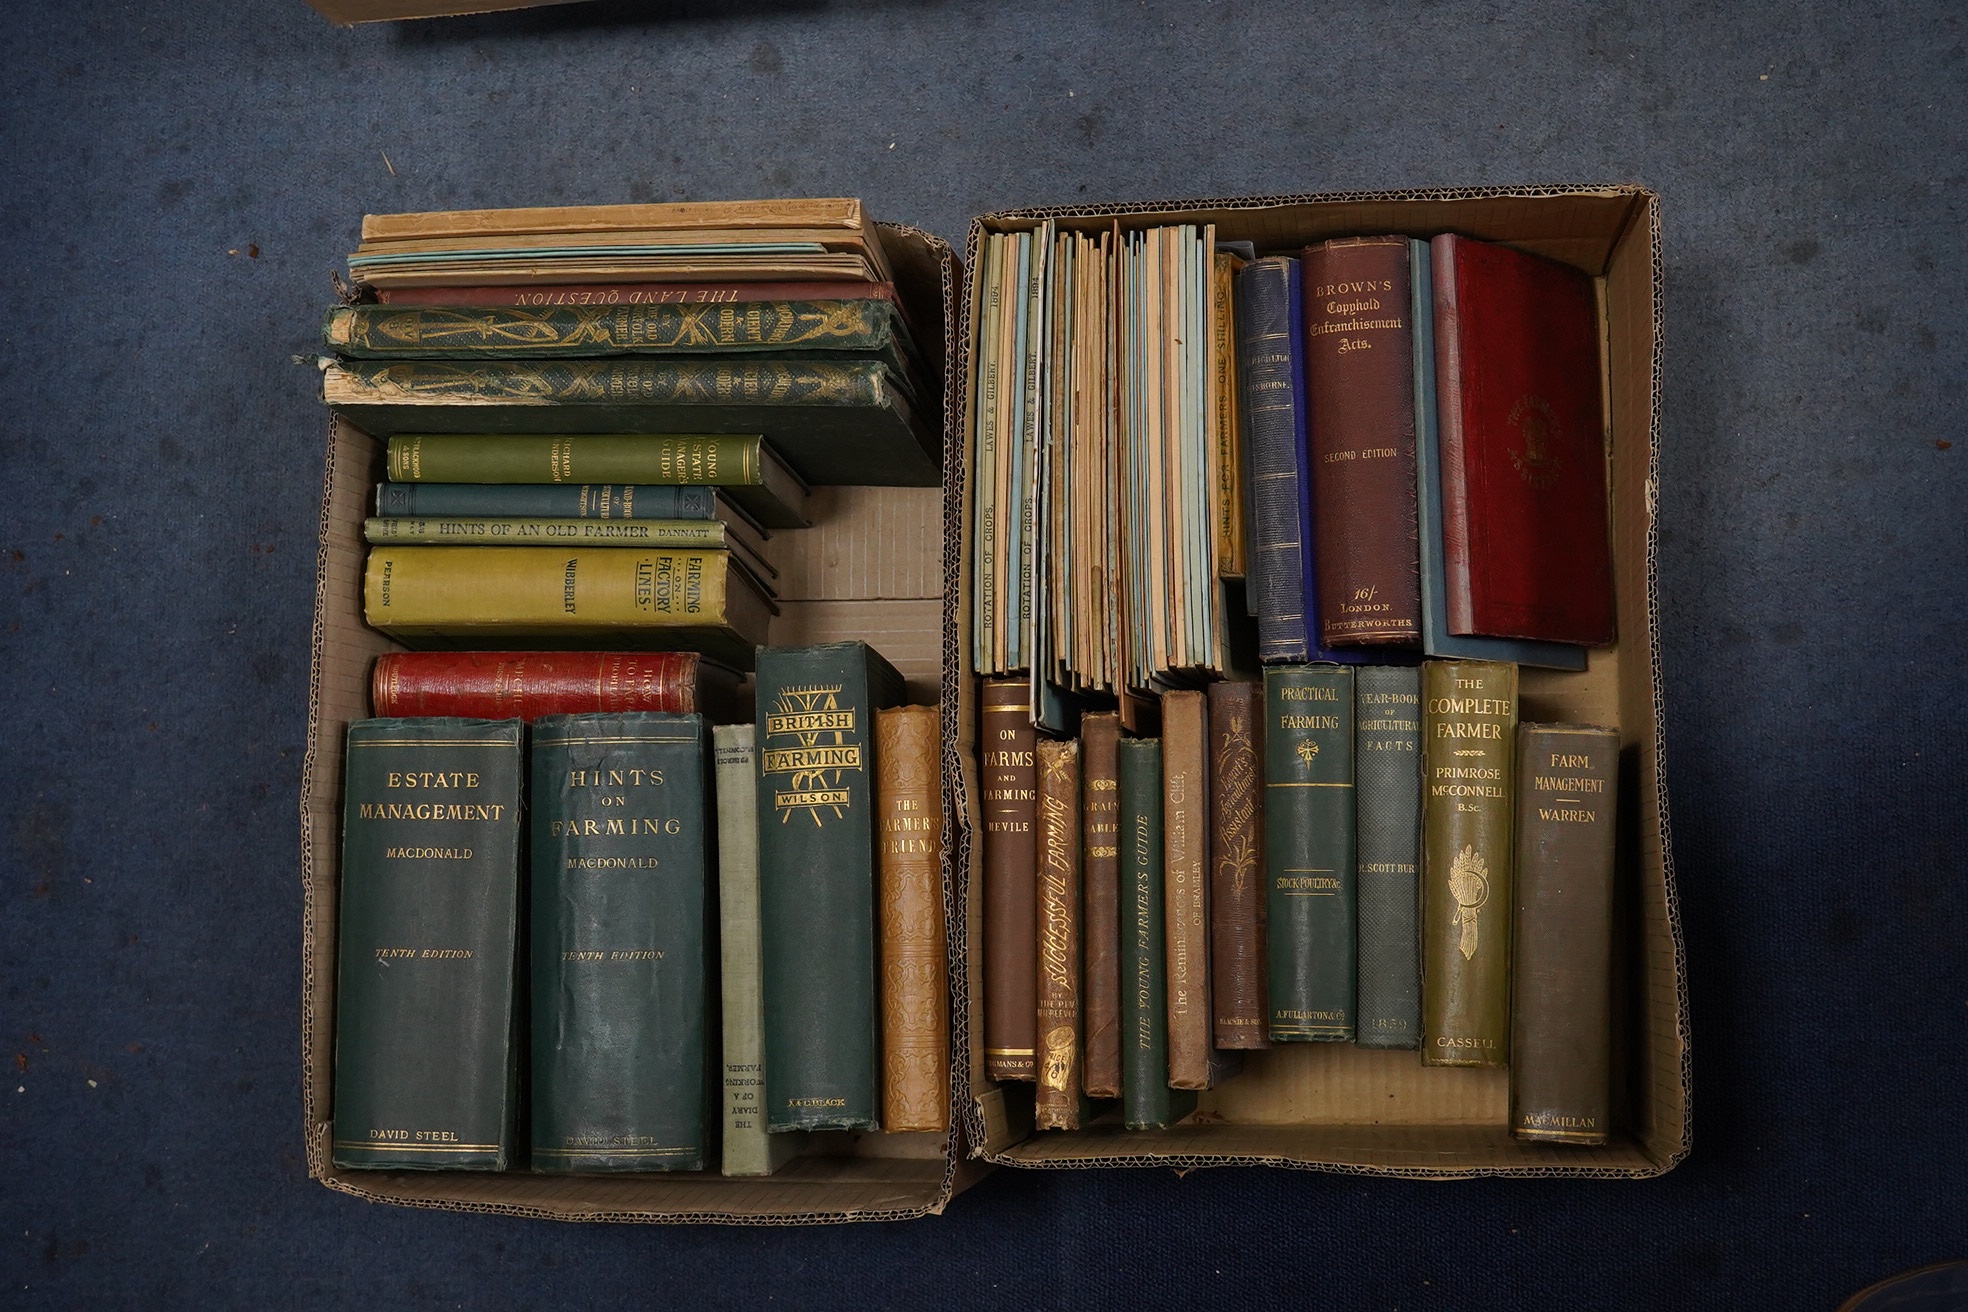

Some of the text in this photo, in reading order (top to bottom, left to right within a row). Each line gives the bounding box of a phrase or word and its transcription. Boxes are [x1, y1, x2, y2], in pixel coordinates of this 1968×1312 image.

[628, 290, 687, 304] LAND
[696, 290, 738, 304] THE
[1315, 280, 1393, 298] BROWN'S
[1326, 298, 1381, 316] Copyhold
[647, 322, 657, 341] OLD
[719, 307, 735, 342] ODERN
[1309, 317, 1403, 337] Enfranchisement
[1337, 338, 1372, 356] Acts.
[1028, 350, 1038, 391] GILBERT.
[1218, 358, 1227, 384] ONE
[987, 360, 997, 401] GILBERT.
[1027, 398, 1035, 406] &
[1026, 413, 1035, 443] LAWES
[1217, 396, 1229, 456] FARMERS
[984, 421, 995, 452] LAWES
[402, 451, 410, 470] SONS
[662, 438, 673, 479] GUIDE
[692, 437, 705, 480] ESTATE
[706, 439, 718, 479] YOUNG
[1324, 447, 1398, 464] SECOND EDITION
[1221, 464, 1230, 491] FOR
[1024, 494, 1033, 533] CROPS.
[1222, 498, 1230, 538] HINTS
[440, 523, 710, 539] HINTS OF AN OLD FARMER DANNATT
[984, 504, 994, 542] CROPS.
[1023, 540, 1031, 555] OF
[985, 550, 992, 565] OF
[382, 561, 393, 607] PEARSON
[564, 558, 578, 615] WIBBERLEY
[657, 557, 673, 614] FACTORY
[674, 576, 681, 593] ON
[687, 557, 703, 614] FARMING
[1022, 563, 1032, 620] ROTATION
[984, 573, 992, 629] ROTATION
[1354, 585, 1379, 601] 16/-
[627, 660, 638, 676] TO
[642, 669, 653, 703] HOW
[1456, 679, 1484, 689] THE
[1281, 687, 1339, 702] PRACTICAL
[1428, 698, 1511, 716] COMPLETE
[772, 714, 849, 731] BRITISH
[1281, 715, 1339, 730] FARMING
[1437, 722, 1502, 740] FARMER
[1000, 729, 1016, 741] ON
[1366, 741, 1413, 751] FACTS
[767, 749, 858, 769] FARMING
[984, 751, 1034, 767] FARMS
[1551, 754, 1589, 769] FARM
[388, 772, 480, 788] ESTATE
[570, 769, 665, 787] HINTS
[1436, 767, 1501, 780] PRIMROSE
[1170, 771, 1188, 804] Clift,
[1534, 776, 1605, 794] MANAGEMENT
[601, 796, 625, 807] ON
[781, 793, 845, 804] WILSON.
[984, 789, 1036, 801] FARMING
[360, 803, 504, 821] MANAGEMENT
[896, 800, 918, 811] THE
[1538, 808, 1596, 823] WARREN
[552, 819, 682, 837] FARMING
[879, 817, 940, 832] FARMER'S
[1044, 794, 1069, 872] FARMING
[1085, 823, 1120, 833] ABLE
[1220, 797, 1257, 857] Assistant
[1171, 810, 1185, 864] William
[387, 847, 473, 860] MACDONALD
[882, 840, 936, 854] FRIEND
[567, 857, 659, 870] MACDONALD
[1367, 863, 1396, 873] SCOTT
[1397, 863, 1417, 873] BUR
[1172, 869, 1186, 884] of
[1192, 860, 1202, 926] OF BRAMLEY
[1040, 873, 1072, 991] SUCCESSFUL
[1136, 814, 1151, 1050] THE YOUNG FARMER'S GUIDE
[375, 948, 474, 960] TENTH EDITION
[561, 950, 665, 961] TENTH EDITION
[1174, 989, 1188, 1018] The
[1436, 1036, 1496, 1049] CASSELL
[726, 1064, 762, 1072] FARMER
[1017, 1060, 1024, 1068] &
[725, 1078, 764, 1086] WORKING
[731, 1107, 758, 1115] DIARY
[811, 1098, 846, 1107] BLACK
[735, 1120, 753, 1129] THE
[1523, 1115, 1596, 1128] MACMILLAN
[370, 1129, 459, 1142] DAVID STEEL
[566, 1136, 659, 1147] DAVID STEEL
